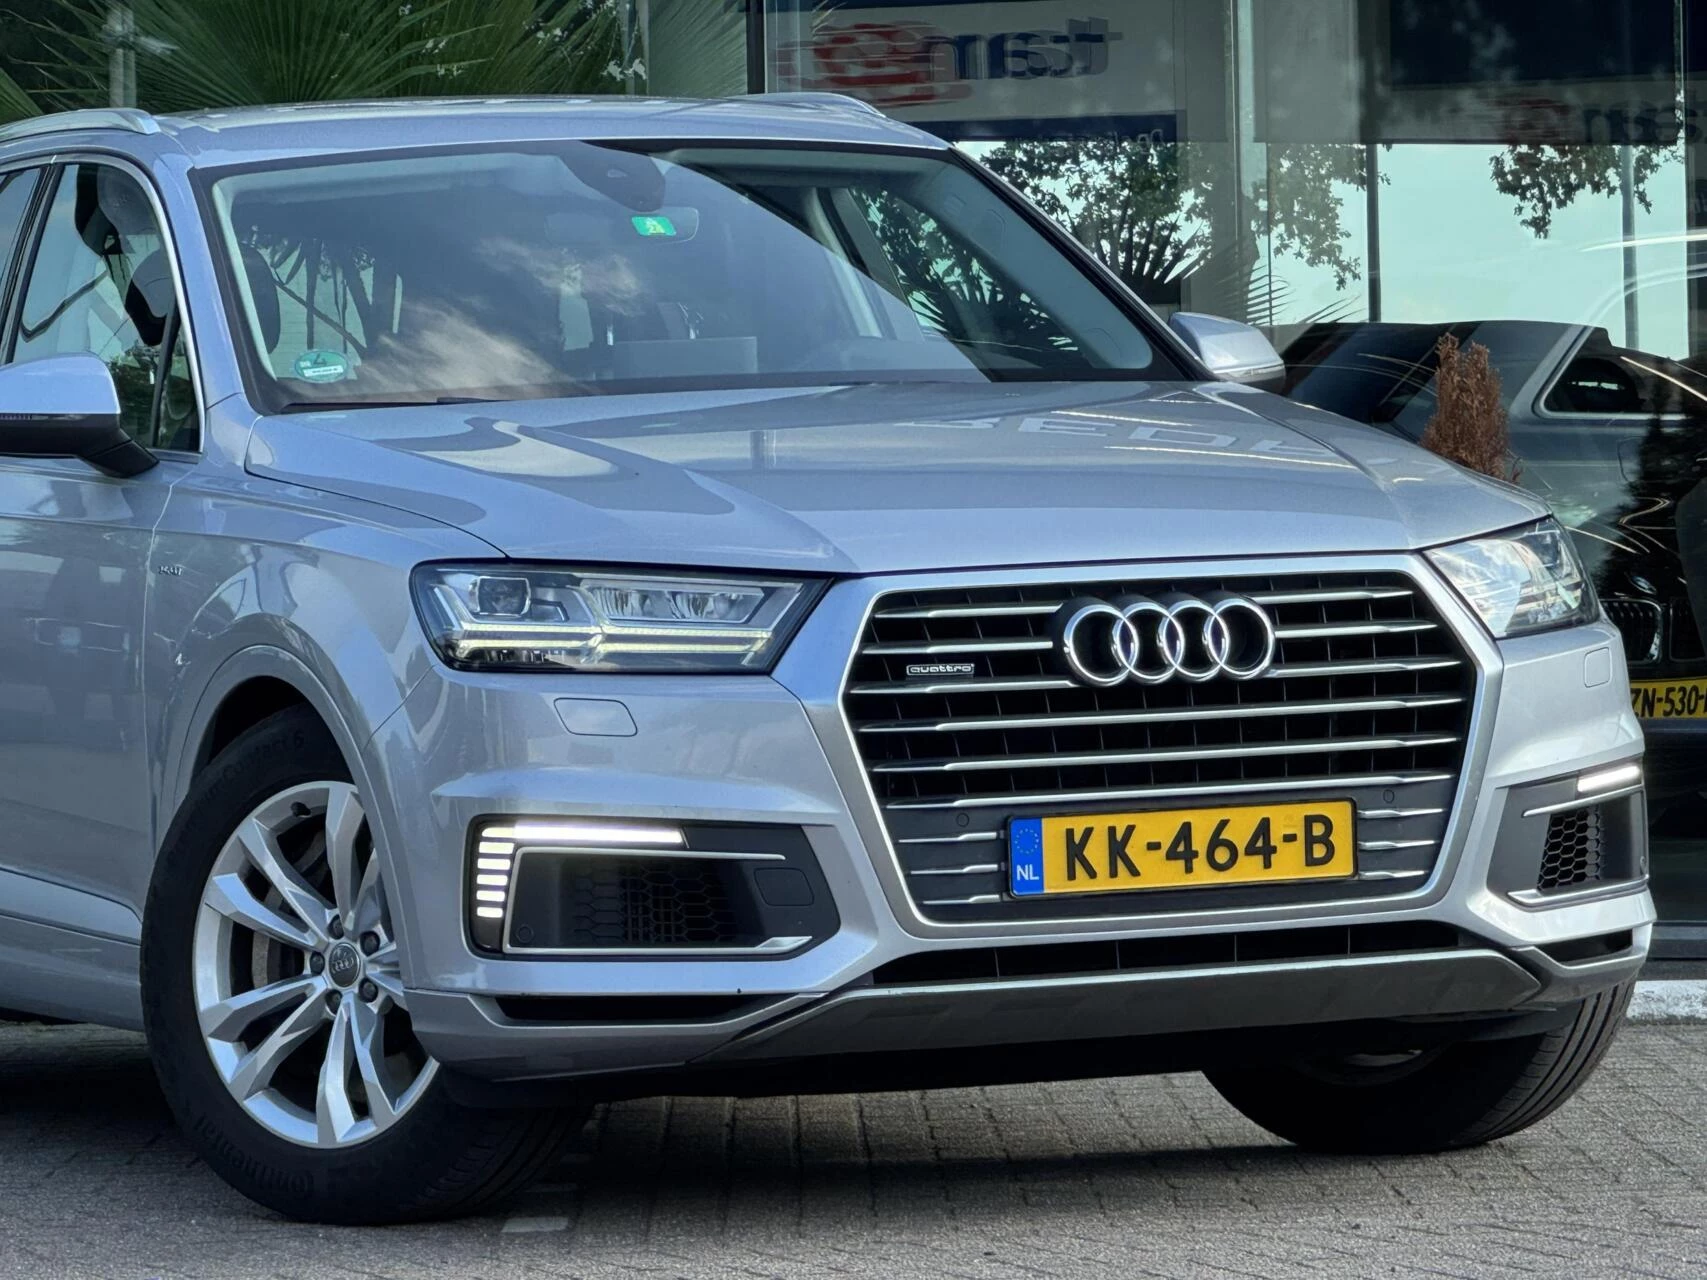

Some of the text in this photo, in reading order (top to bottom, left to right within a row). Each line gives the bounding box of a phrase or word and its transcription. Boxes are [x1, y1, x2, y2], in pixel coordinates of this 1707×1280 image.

[910, 665, 972, 673] quattro
[1065, 814, 1336, 881] KK-464-B
[1016, 864, 1040, 881] NL
